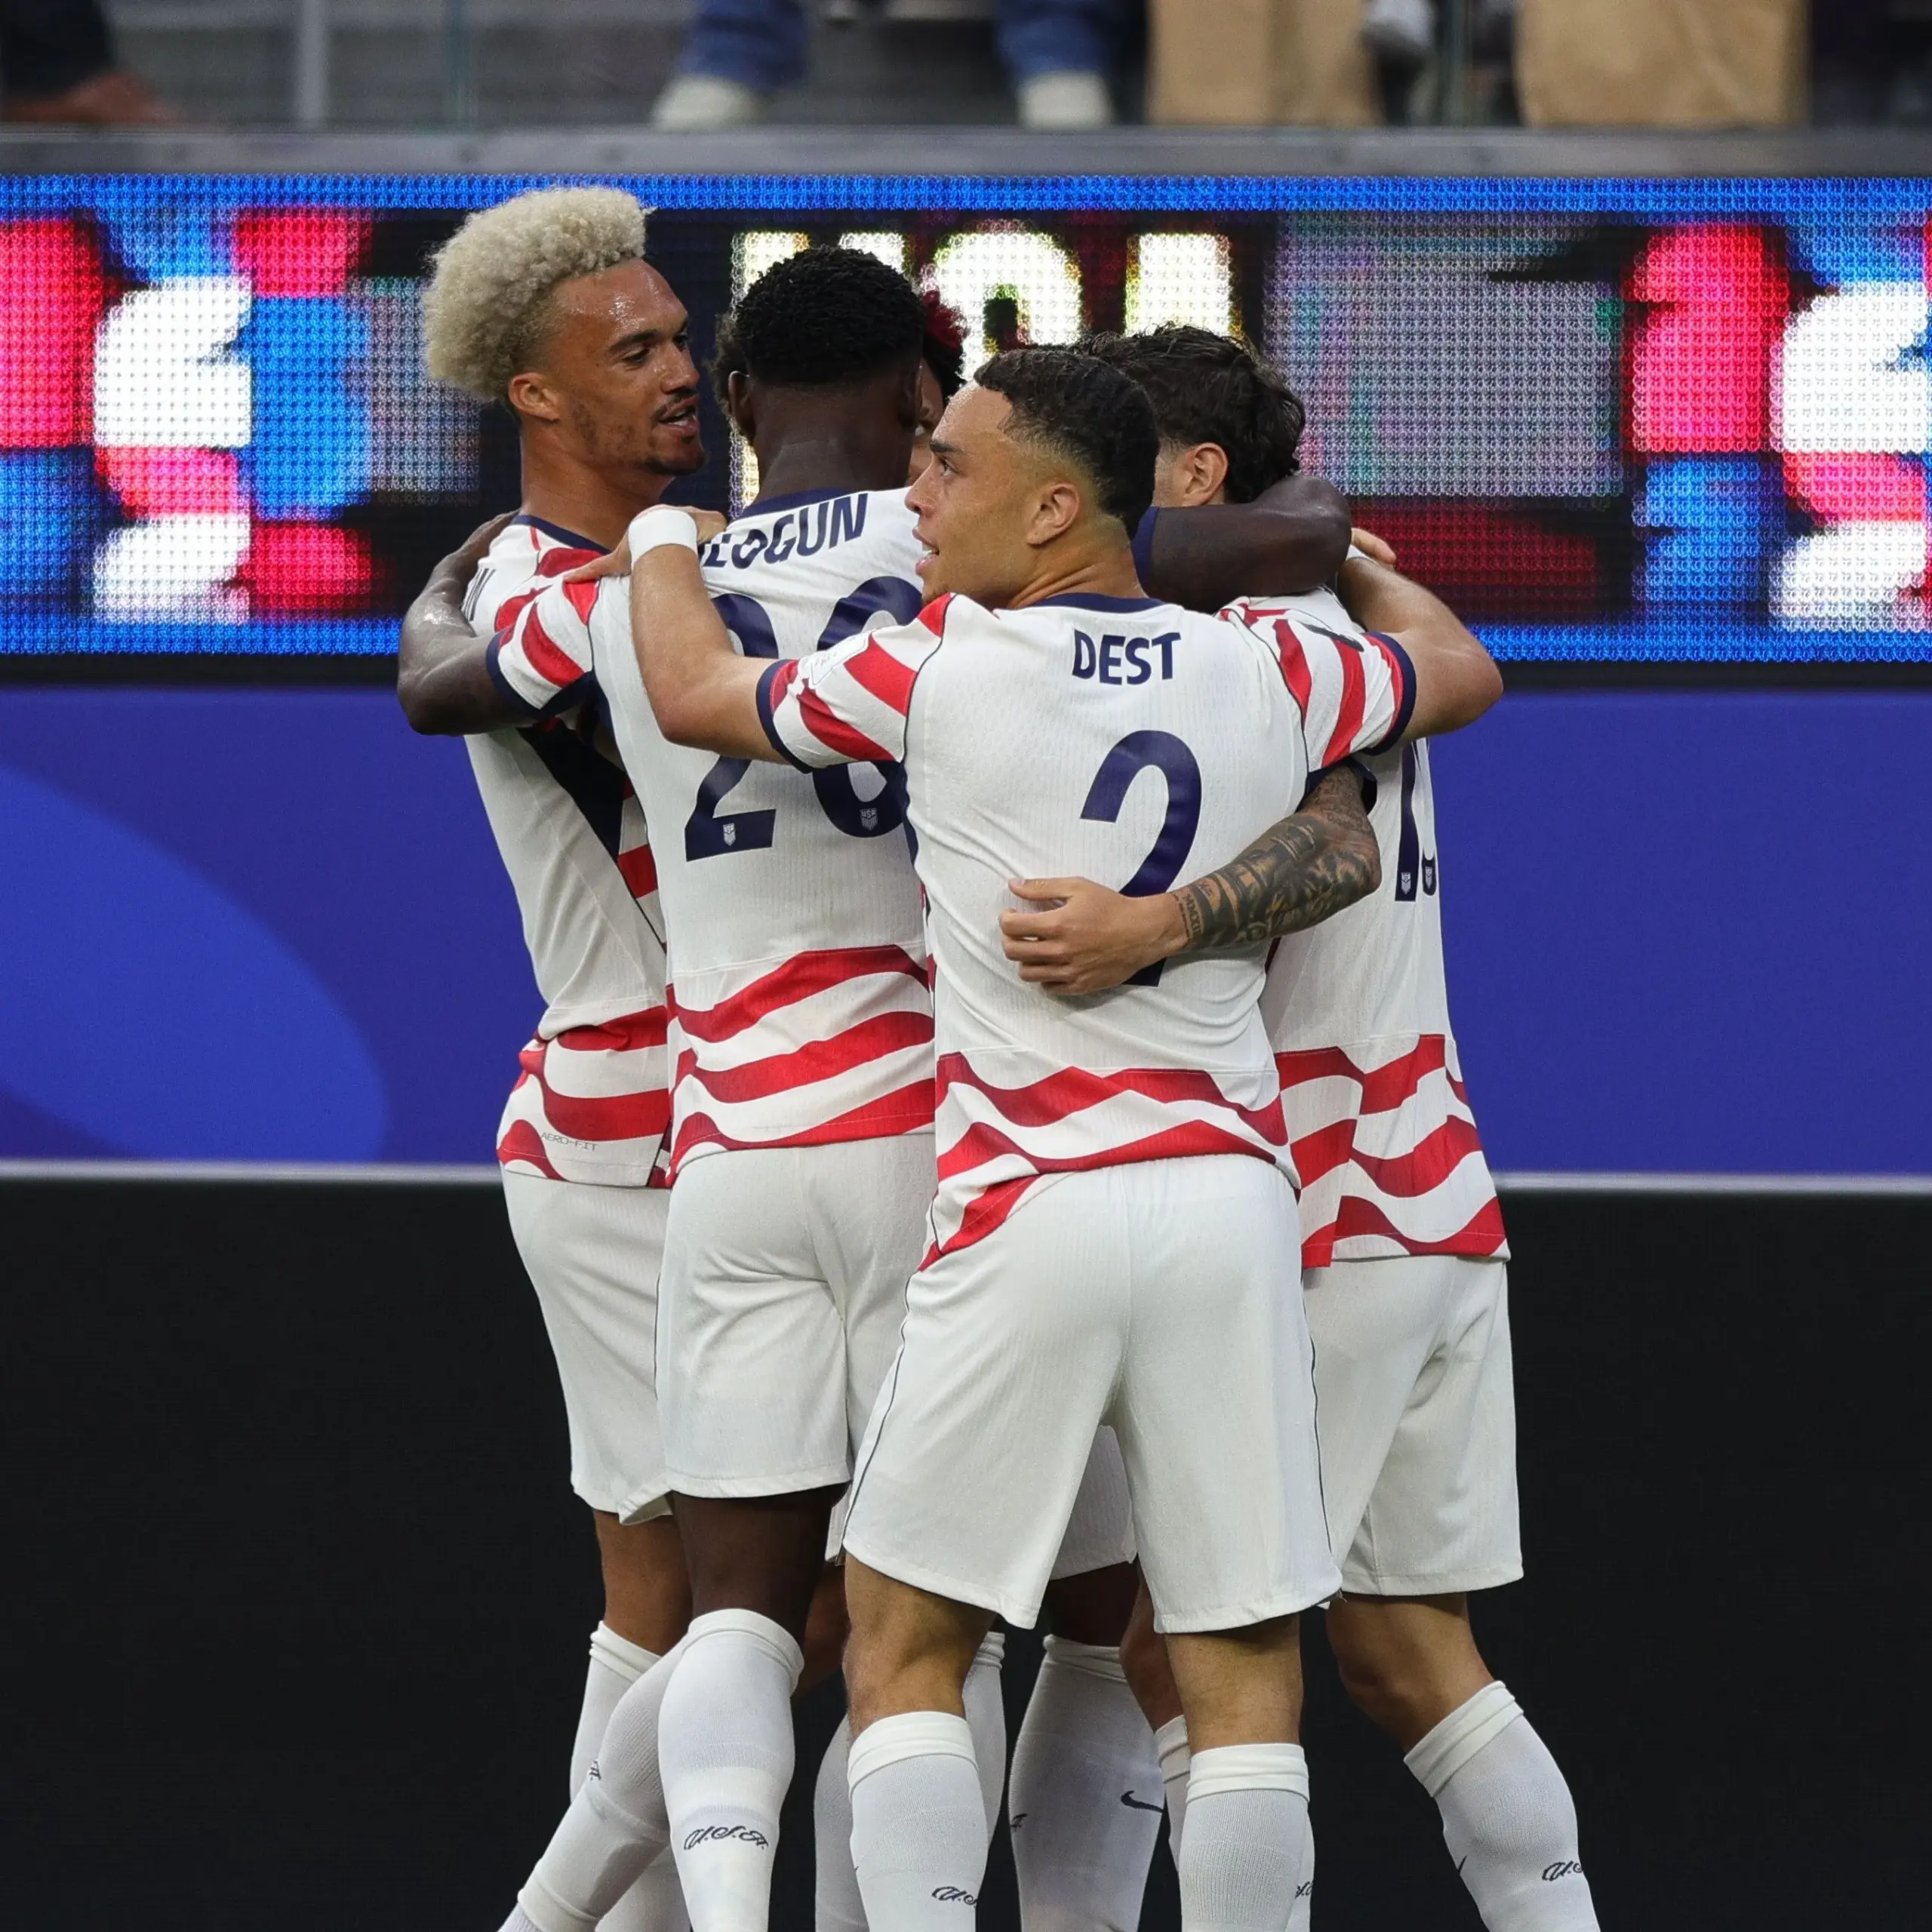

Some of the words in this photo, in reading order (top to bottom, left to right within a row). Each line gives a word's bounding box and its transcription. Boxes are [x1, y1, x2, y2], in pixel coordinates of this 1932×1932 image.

[698, 493, 869, 570] LOGUN
[1072, 628, 1181, 685] DEST
[1080, 729, 1202, 987] 2
[541, 1133, 600, 1151] AERO-FIT
